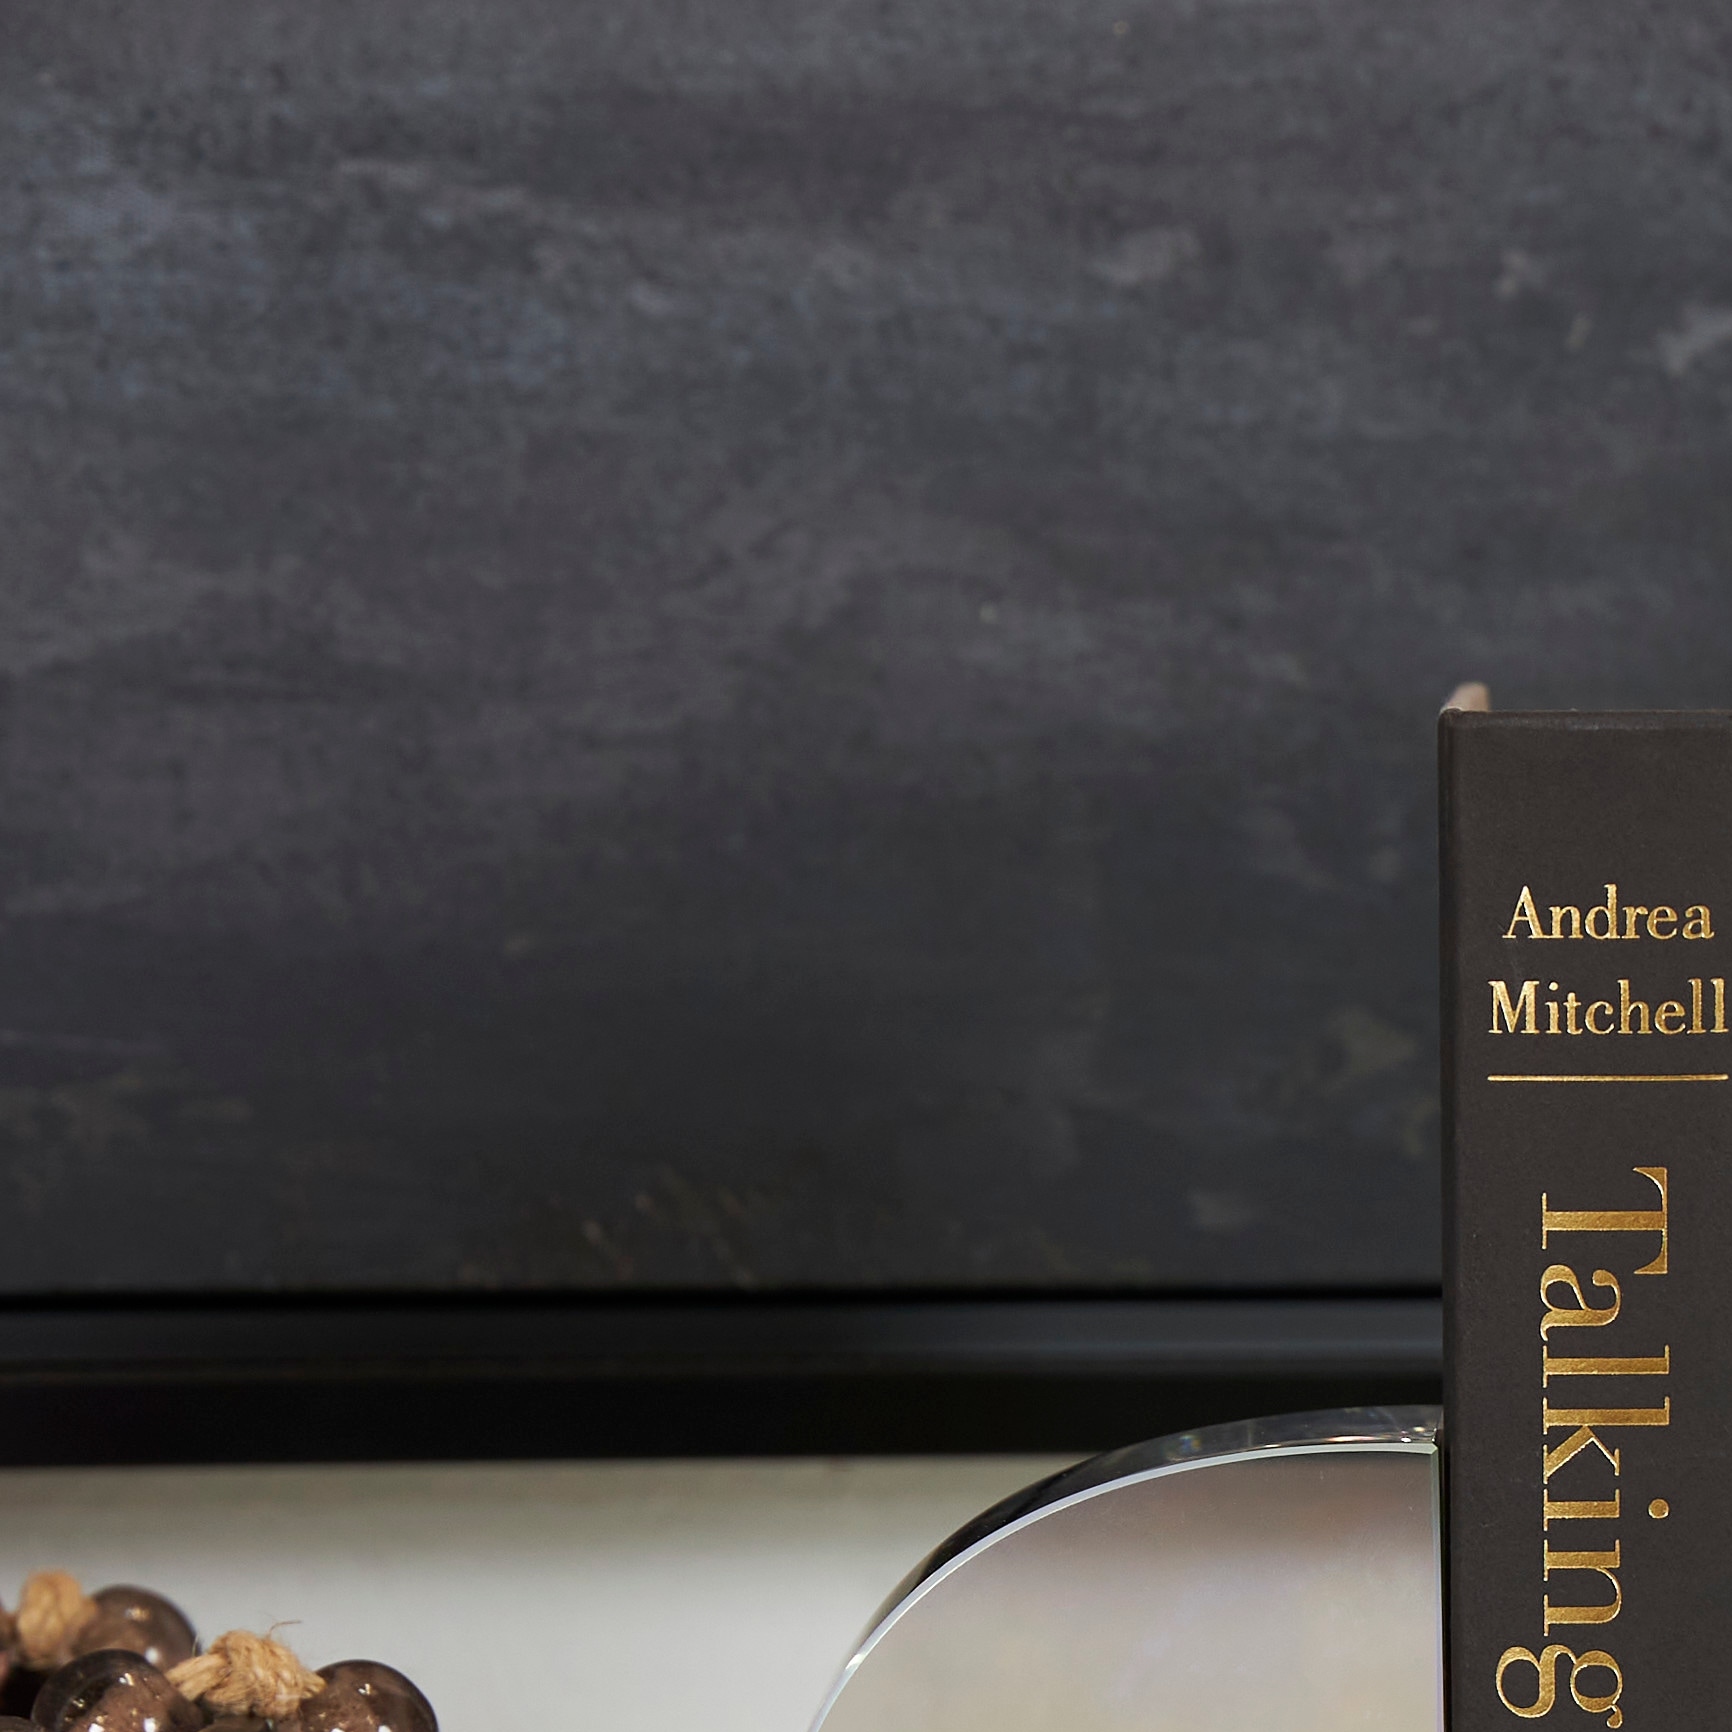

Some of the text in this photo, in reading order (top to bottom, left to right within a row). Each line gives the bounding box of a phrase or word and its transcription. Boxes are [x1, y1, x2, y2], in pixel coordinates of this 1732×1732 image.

[1503, 883, 1716, 941] Andrea
[1488, 977, 1730, 1036] Mitchell
[1495, 1165, 1671, 1731] Talking
